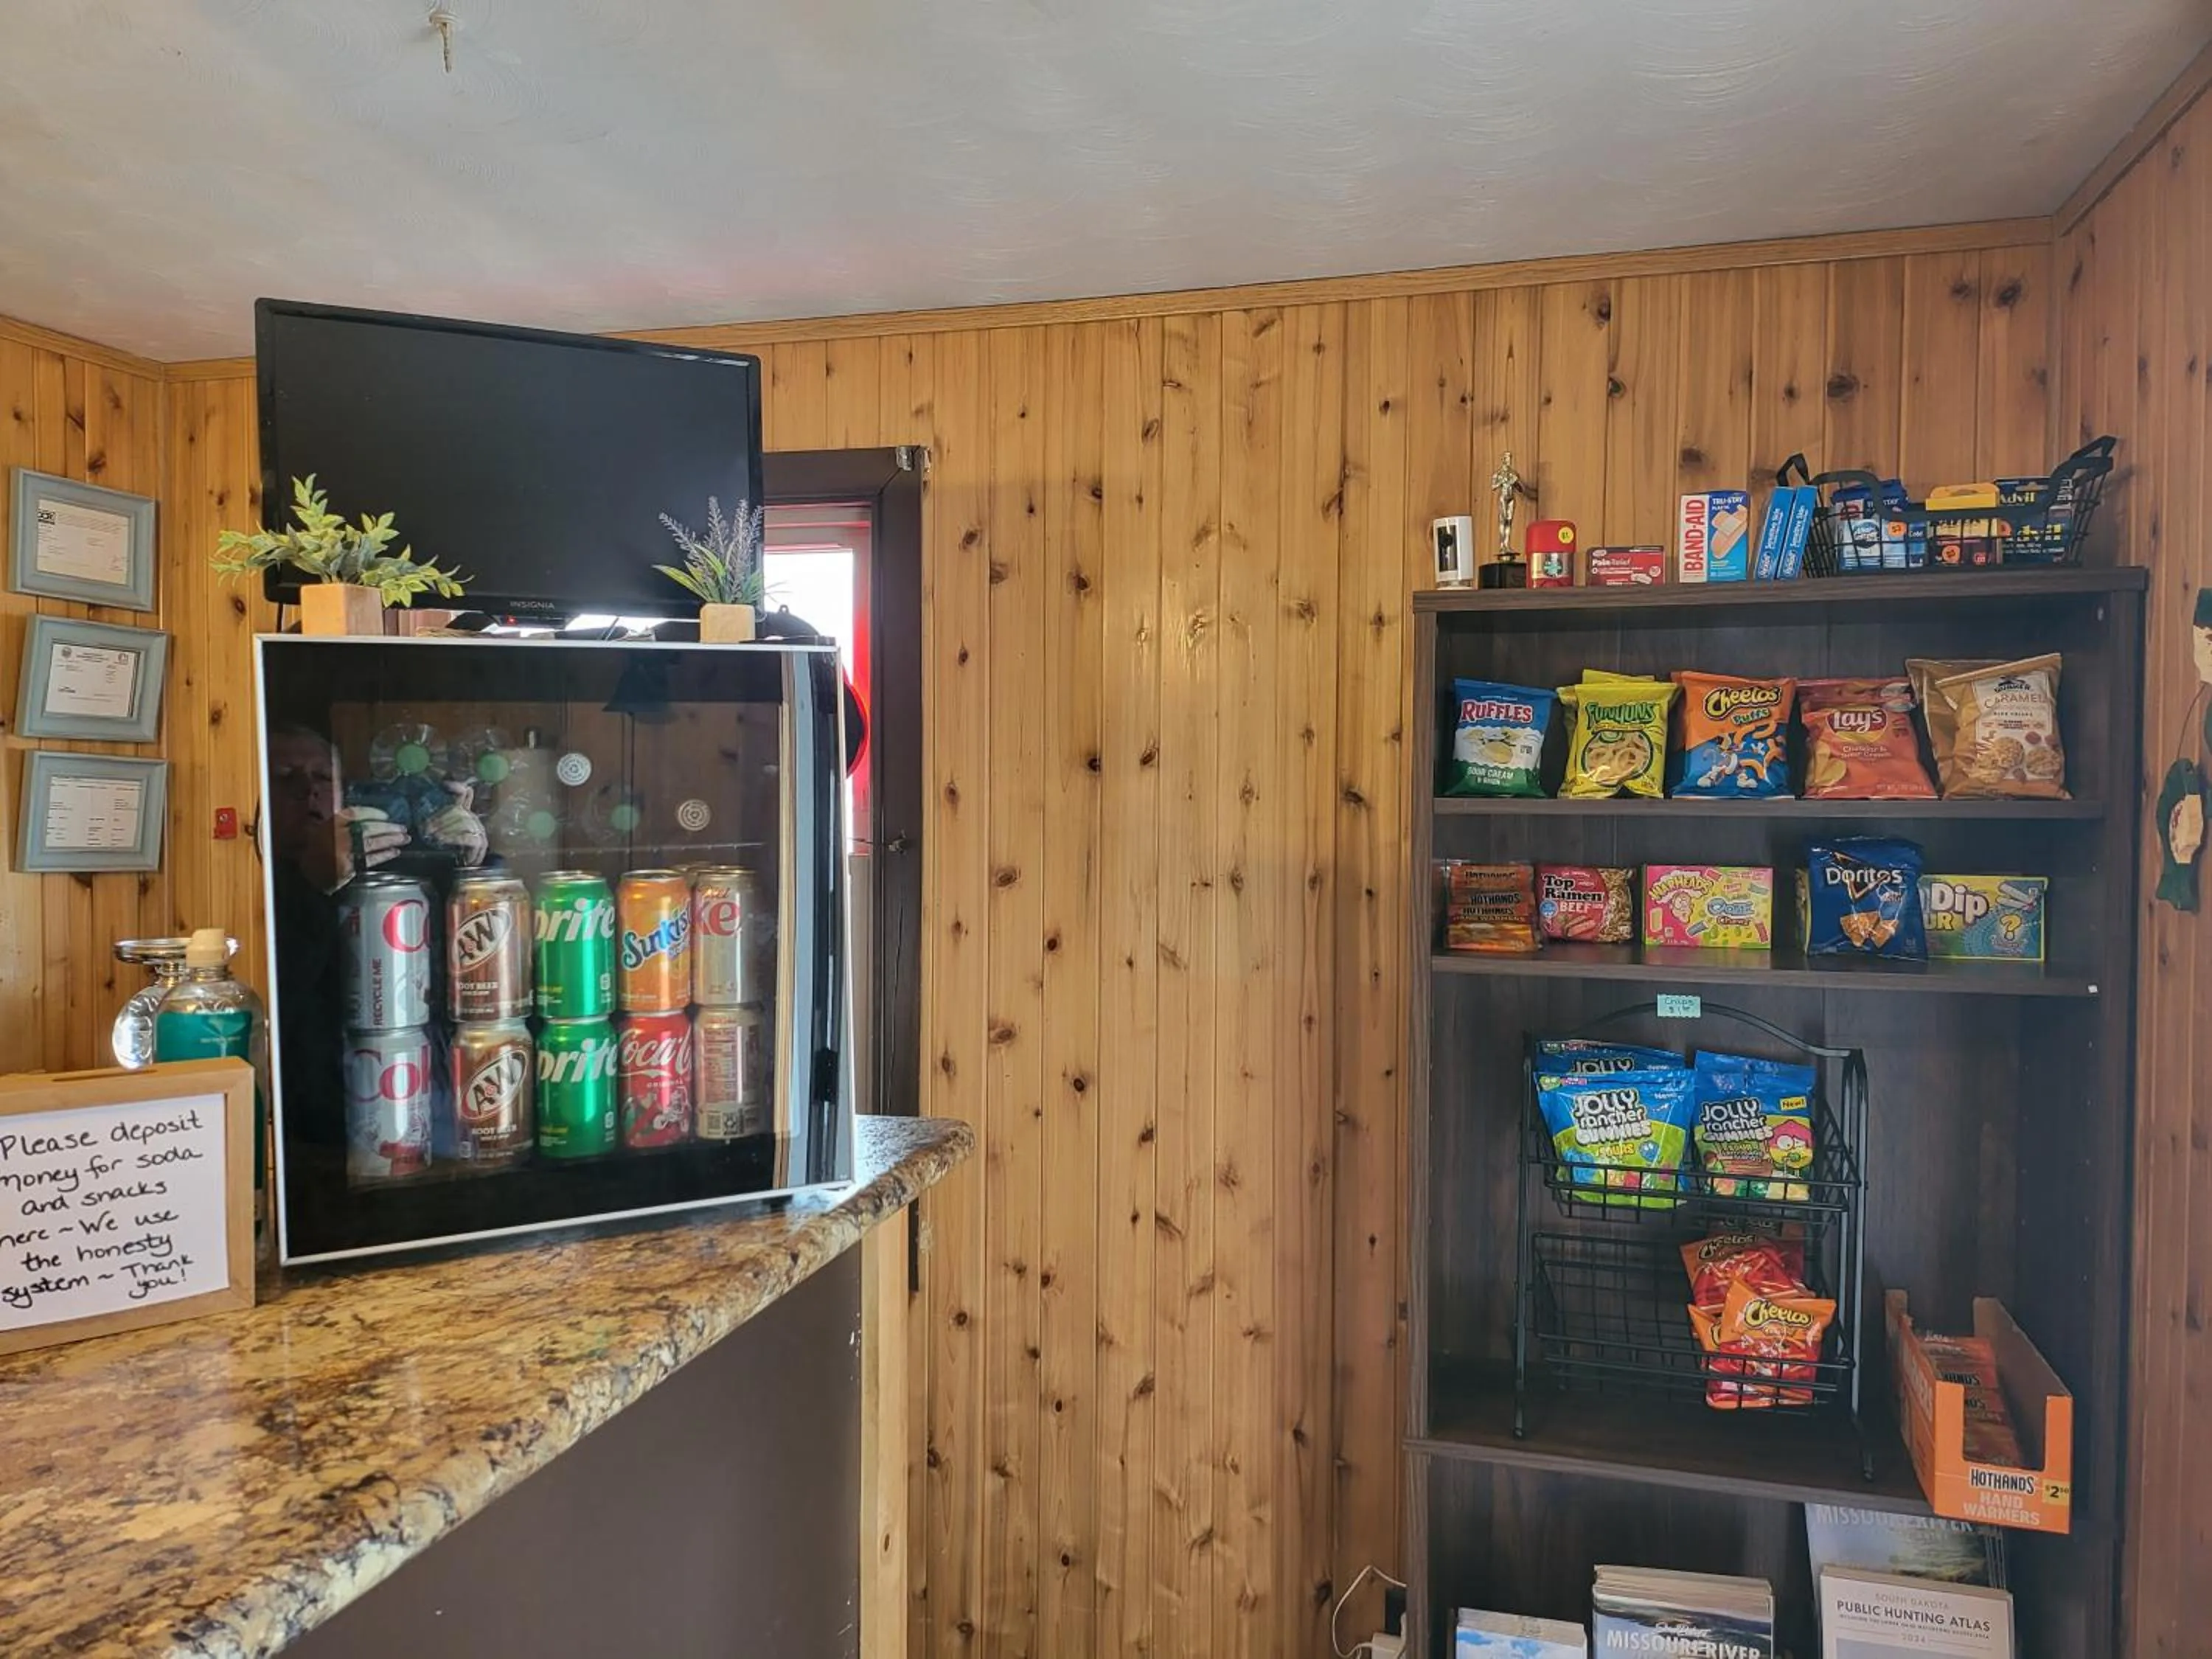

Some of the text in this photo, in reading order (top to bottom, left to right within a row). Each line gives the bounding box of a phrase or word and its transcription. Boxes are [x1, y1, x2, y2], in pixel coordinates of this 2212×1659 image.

[1684, 499, 1705, 572] BAND-AID
[509, 601, 555, 609] INSIGNIA
[1460, 700, 1533, 723] RUFFLES
[1705, 687, 1781, 718] Cheetos
[1984, 692, 2048, 709] CARAMEL
[1733, 707, 1770, 724] Puffs
[1833, 710, 1883, 733] Lay's
[1543, 875, 1575, 891] Top
[1826, 867, 1902, 886] Doritos
[1545, 888, 1604, 902] Ramen
[1931, 883, 1989, 924] Dip
[1559, 902, 1588, 913] BEEF
[1924, 913, 1954, 930] UR
[373, 959, 382, 1026] RECYCLE ME
[1574, 1089, 1638, 1117] JOLLY
[1702, 1100, 1759, 1121] JOLLY
[1782, 1098, 1805, 1109] New!
[1579, 1107, 1646, 1129] rancher
[1706, 1116, 1766, 1133] rancher
[0, 1110, 204, 1161] Please deposit
[1576, 1121, 1652, 1145] GUMMIES
[1703, 1126, 1774, 1142] GUMMIES
[0, 1146, 204, 1192] money for soda
[21, 1180, 168, 1216] and snacks
[79, 1211, 119, 1235] We
[135, 1208, 180, 1226] use
[21, 1233, 173, 1271] the honesty
[1698, 1234, 1756, 1261] Cheetos
[1, 1276, 90, 1309] system
[120, 1253, 195, 1280] Thank
[128, 1269, 187, 1299] you!
[1745, 1299, 1813, 1326] Cheetos
[1971, 1468, 2035, 1495] HOTHANDS
[1980, 1491, 2024, 1509] HAND
[1964, 1502, 2040, 1526] WARMERS
[1910, 1598, 1948, 1609] DAKOTA
[1837, 1600, 1991, 1632] PUBLIC HUNTING ATLAS
[1607, 1630, 1699, 1656] MISSOURI
[1705, 1641, 1761, 1659] RIVER
